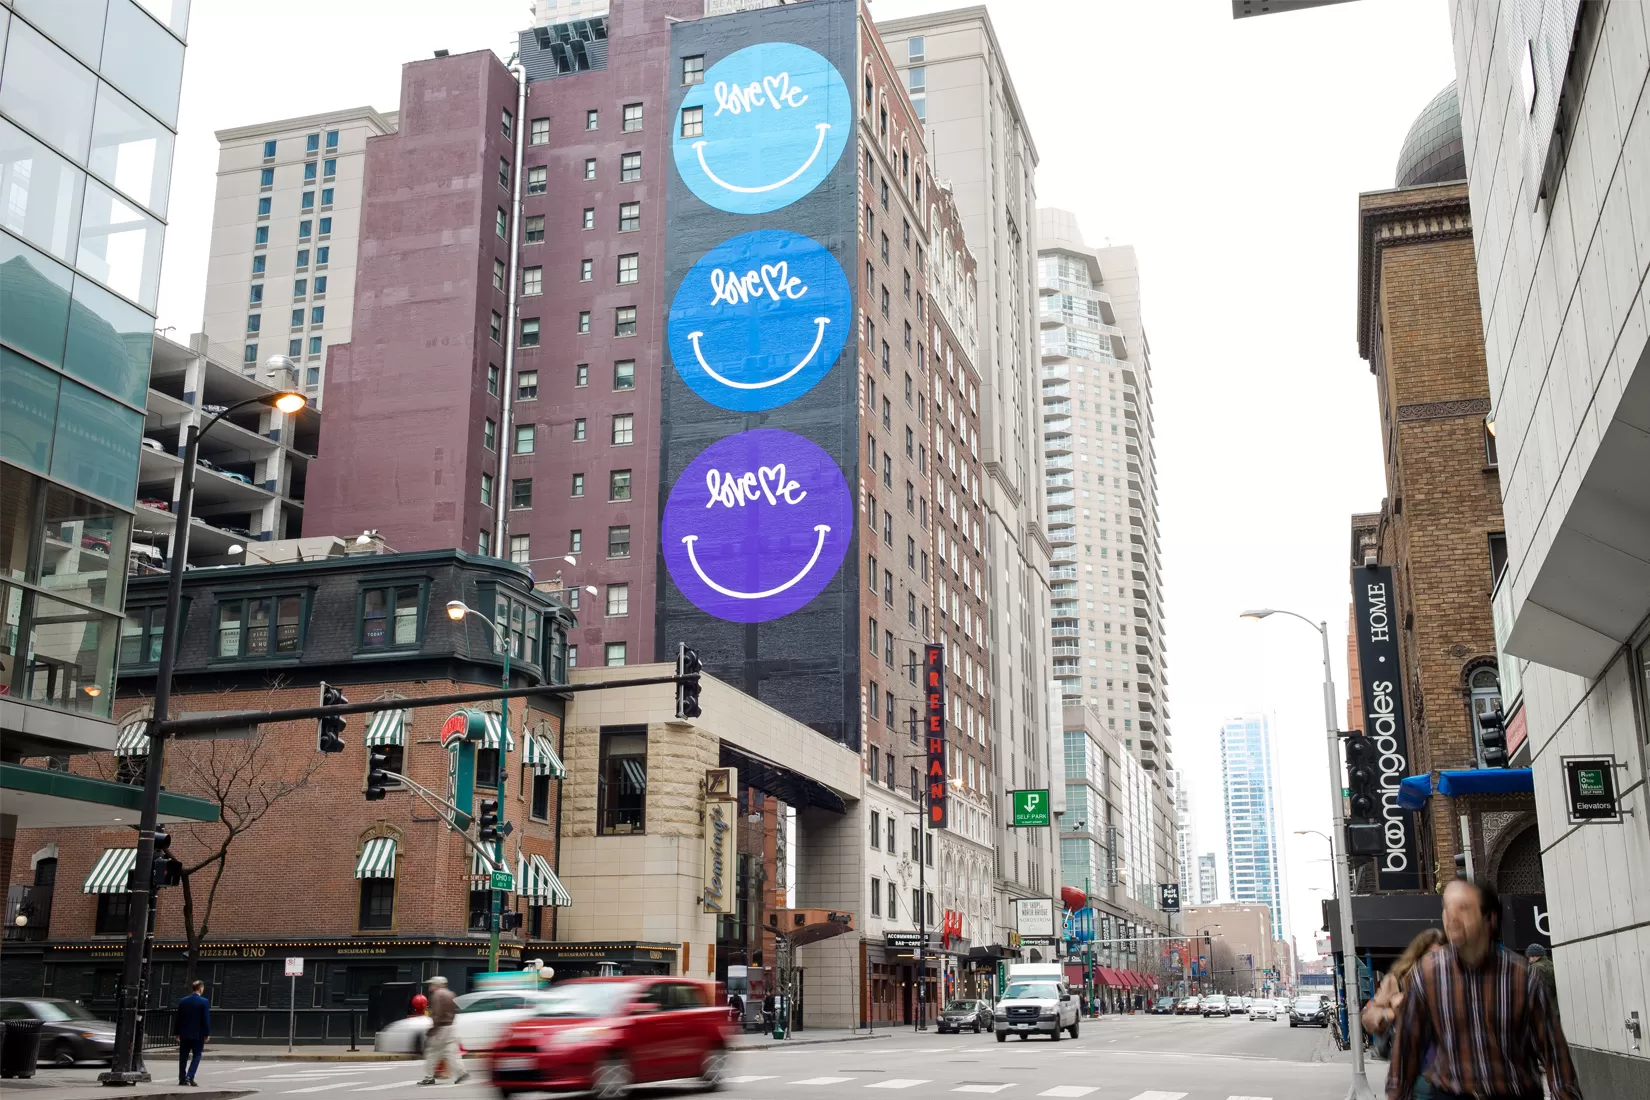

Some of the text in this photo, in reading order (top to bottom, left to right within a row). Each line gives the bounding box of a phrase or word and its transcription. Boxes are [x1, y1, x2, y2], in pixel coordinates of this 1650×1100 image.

[1368, 583, 1389, 642] HOME
[929, 650, 943, 822] FREEHAND
[704, 804, 730, 911] Fleming's
[495, 873, 507, 881] OHIO
[199, 948, 266, 957] PIZZERIA UNO
[477, 948, 509, 956] PIZRIA
